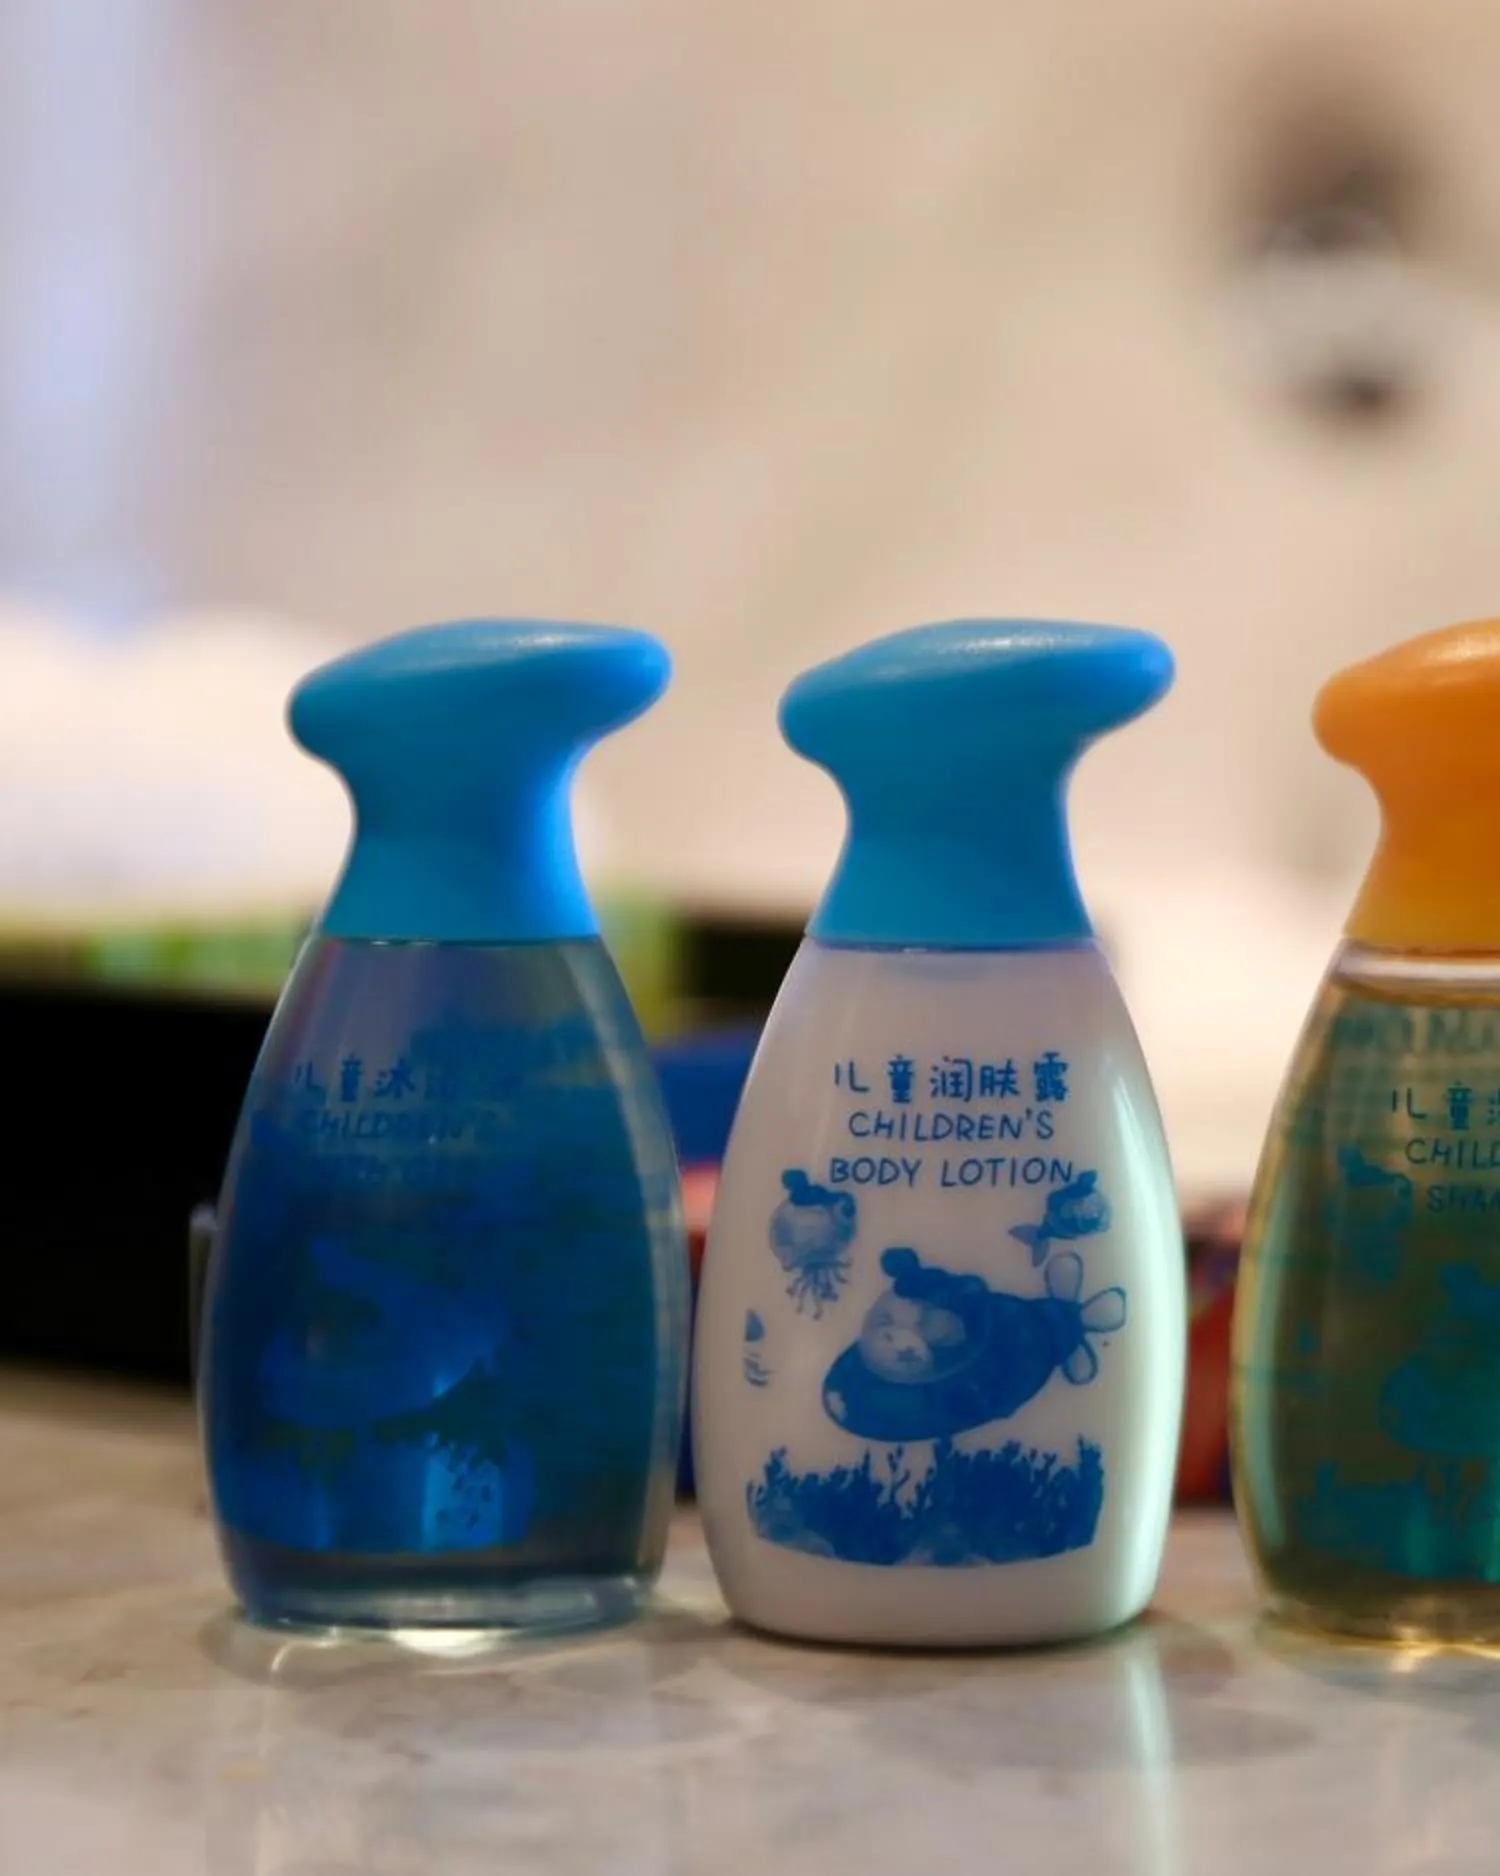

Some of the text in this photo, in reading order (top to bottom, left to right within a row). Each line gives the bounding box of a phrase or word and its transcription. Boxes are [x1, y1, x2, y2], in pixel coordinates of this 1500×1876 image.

[294, 1053, 524, 1102] 儿童沐
[834, 1050, 1071, 1103] 儿童润肤露
[848, 1108, 1055, 1143] CHILDREN'S
[828, 1157, 1074, 1188] BODY LOTION
